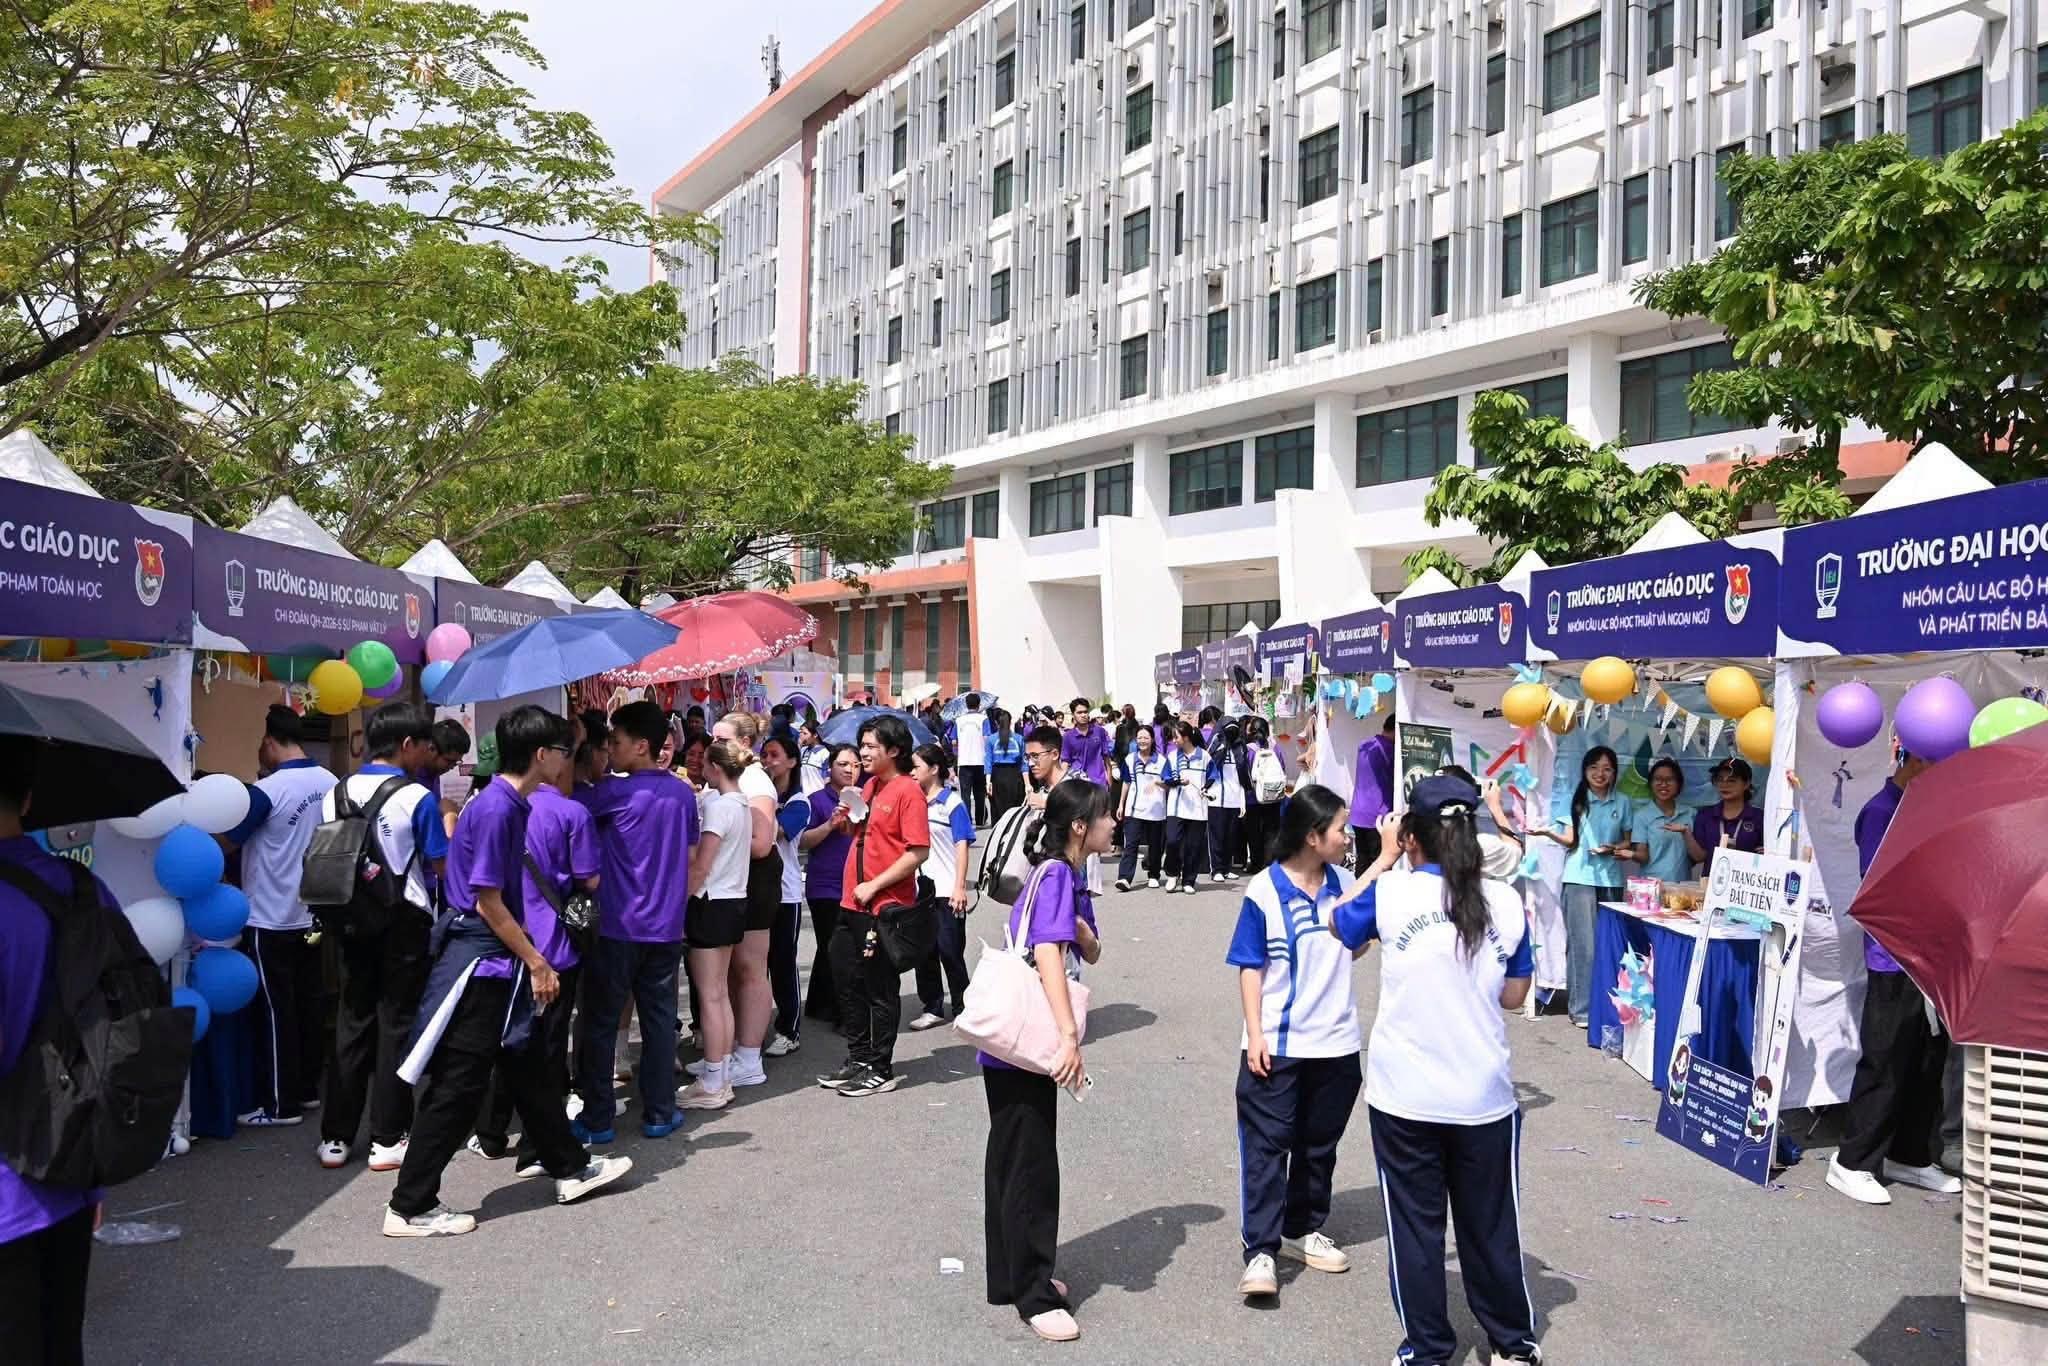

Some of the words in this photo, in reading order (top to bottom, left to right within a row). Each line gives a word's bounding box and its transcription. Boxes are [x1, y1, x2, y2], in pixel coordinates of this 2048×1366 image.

[20, 521, 74, 558] GIÁO
[78, 533, 120, 568] DỤC
[1857, 538, 1945, 577] TRƯỜNG
[1950, 529, 1993, 568] ĐẠI
[0, 571, 38, 595] PHẠM
[40, 574, 74, 598] TOÁN
[77, 581, 103, 601] HỌC
[256, 567, 306, 597] TRƯỜNG
[308, 581, 328, 606] ĐẠI
[331, 585, 353, 608] HỌC
[354, 585, 378, 609] GIÁO
[379, 592, 399, 615] DỤC
[1566, 584, 1606, 609] TRƯỜNG
[1607, 583, 1626, 608] ĐẠI
[1627, 580, 1652, 605] HỌC
[1653, 571, 1684, 598] GIÁO
[1686, 572, 1714, 600] DỤC
[1902, 584, 1943, 609] NHÓM
[1946, 581, 1975, 604] CÂU
[1978, 580, 2007, 604] LẠC
[2010, 574, 2033, 601] BỘ
[274, 608, 288, 622] CHI
[288, 609, 309, 625] ĐOÀN
[1462, 605, 1478, 625] GIÁO
[1479, 606, 1494, 626] DỤC
[1597, 619, 1609, 633] LẠC
[1609, 615, 1619, 633] BỘ
[1619, 616, 1634, 632] HỌC
[1634, 611, 1657, 630] THUẬT
[1657, 611, 1667, 627] VÀ
[1667, 612, 1691, 628] NGOẠI
[1692, 607, 1710, 625] NGỮ
[1919, 615, 1937, 636] VÀ
[1939, 613, 1976, 635] PHÁT
[1978, 606, 2022, 632] TRIỂN
[1730, 869, 1756, 887] TRANG
[1756, 872, 1781, 893] SÁCH
